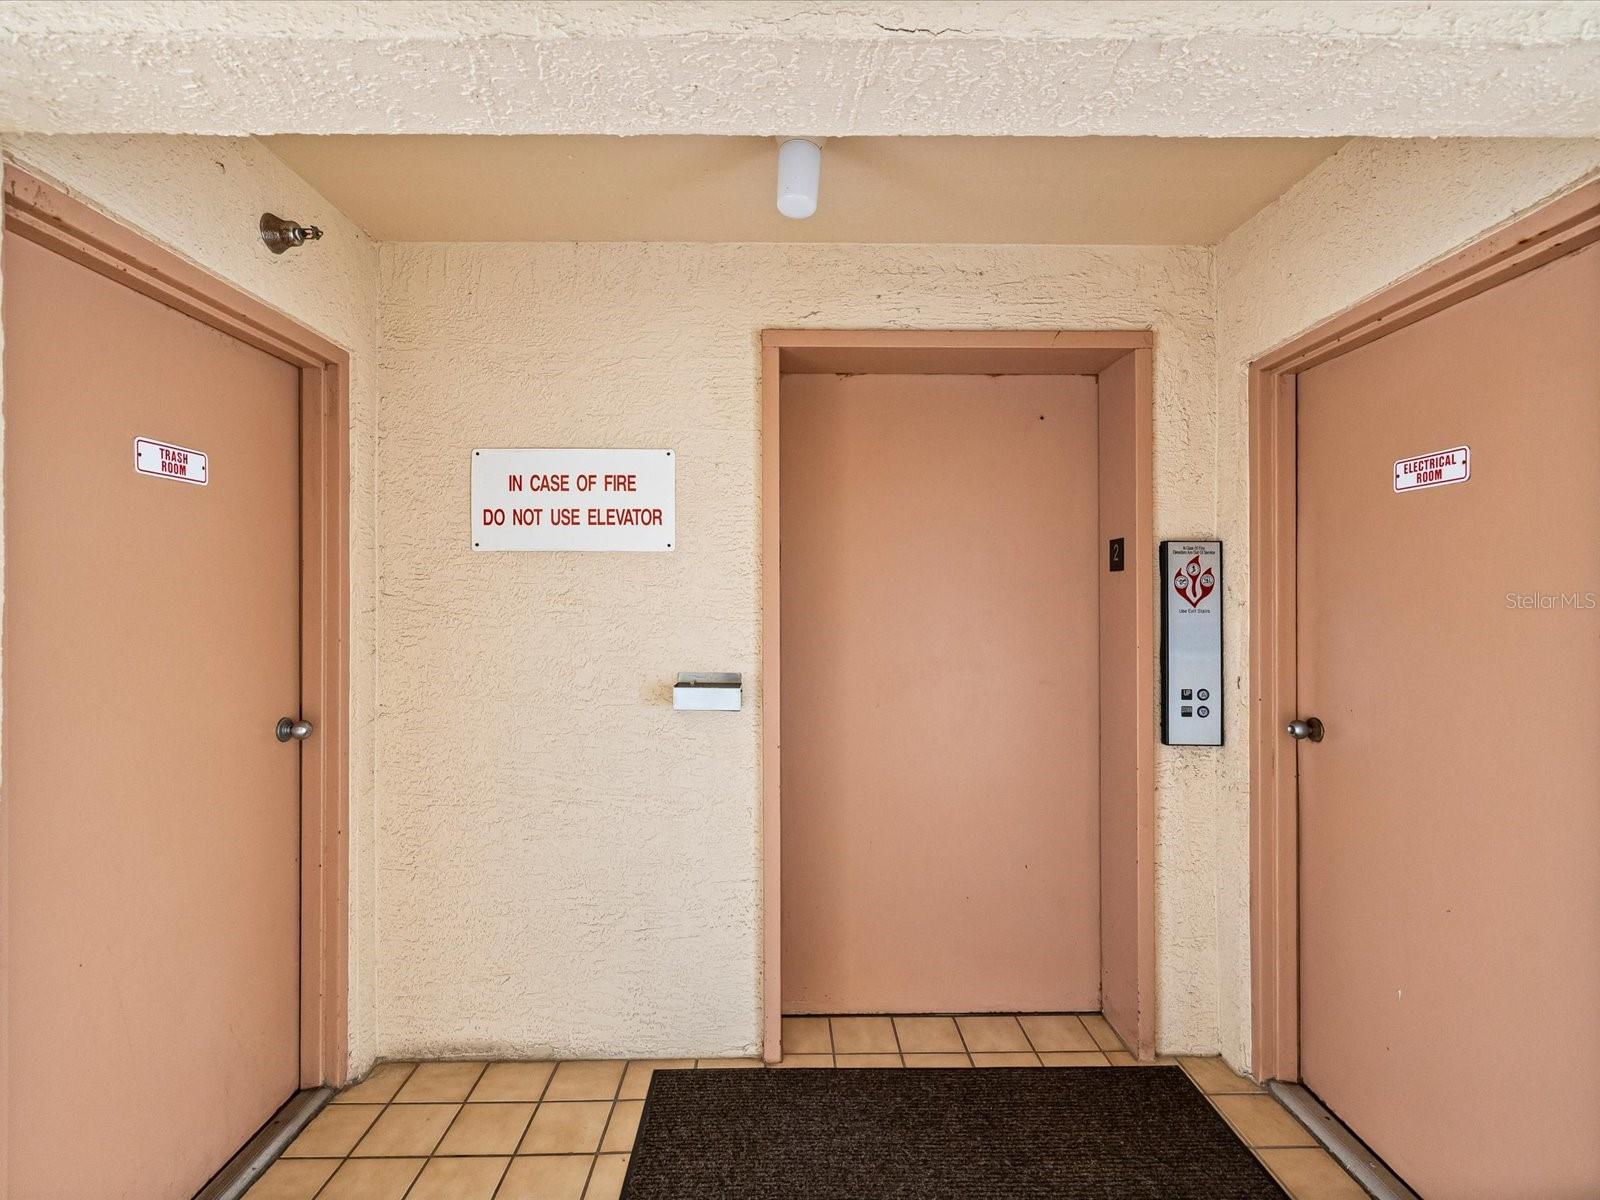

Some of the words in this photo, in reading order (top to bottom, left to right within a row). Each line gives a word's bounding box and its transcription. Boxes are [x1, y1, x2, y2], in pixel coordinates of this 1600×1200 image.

[159, 448, 188, 464] TRASH
[1403, 454, 1457, 475] ELECTRICAL
[161, 461, 187, 476] ROOM
[1416, 469, 1443, 483] ROOM
[508, 474, 523, 492] IN
[530, 474, 570, 492] CASE
[576, 474, 597, 492] OF
[604, 474, 637, 492] FIRE
[483, 508, 505, 526] DO
[512, 508, 543, 526] NOT
[550, 508, 580, 526] USE
[587, 508, 663, 526] ELEVATOR
[1113, 544, 1119, 561] 2
